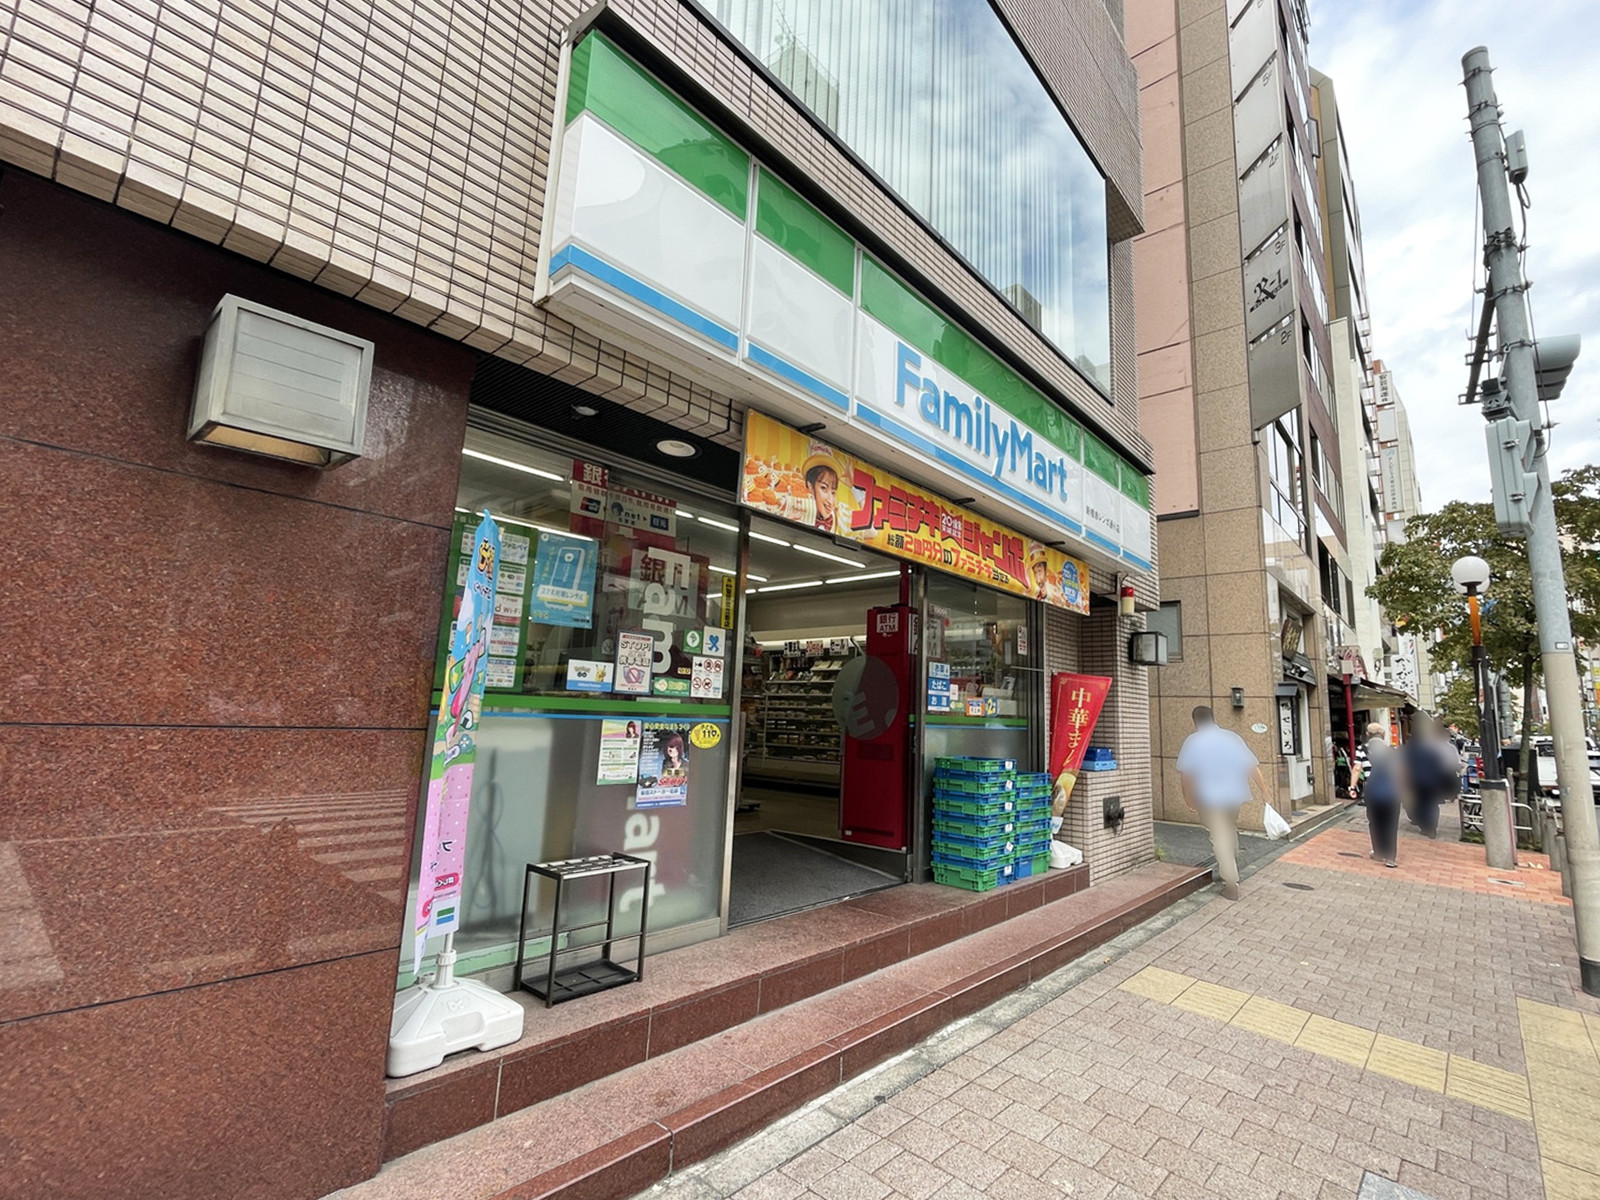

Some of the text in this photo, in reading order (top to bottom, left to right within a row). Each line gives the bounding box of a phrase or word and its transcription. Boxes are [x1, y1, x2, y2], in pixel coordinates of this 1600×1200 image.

[1262, 69, 1273, 87] 5F
[1268, 153, 1281, 168] 4F
[1274, 239, 1287, 256] 3F
[1280, 330, 1292, 345] 2F
[896, 341, 1067, 501] FamilyMart
[850, 468, 941, 538] ファミチキ
[963, 519, 1029, 589] ジャンボ
[503, 604, 521, 614] Wi-Fi
[878, 613, 897, 624] 銀行
[878, 623, 896, 632] ATM
[620, 640, 651, 652] STOP!
[931, 680, 947, 690] たばこ
